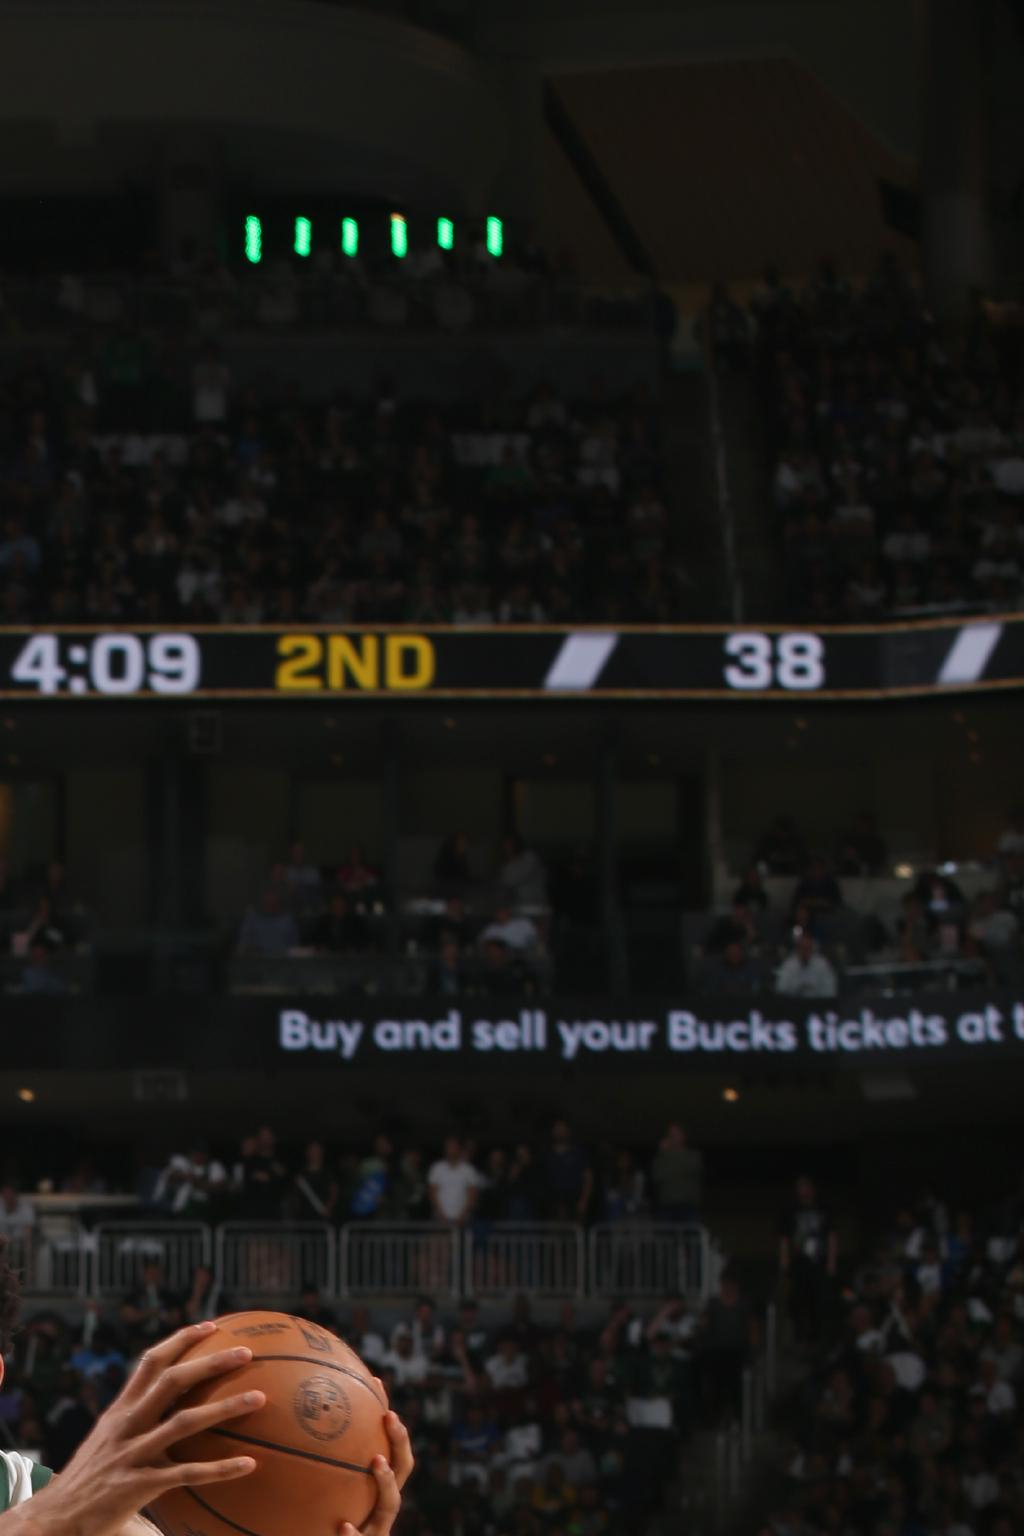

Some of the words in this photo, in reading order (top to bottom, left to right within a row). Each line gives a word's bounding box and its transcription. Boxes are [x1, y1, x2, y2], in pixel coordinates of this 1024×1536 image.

[11, 633, 200, 695] 4:09
[277, 634, 434, 693] 2ND
[725, 631, 823, 689] 38
[280, 1011, 362, 1058] Buy
[374, 1011, 461, 1050] and
[473, 1010, 546, 1050] sell
[558, 1020, 656, 1059] your
[668, 1011, 797, 1051] Bucks
[808, 1008, 947, 1051] tickets
[957, 1004, 1003, 1043] at
